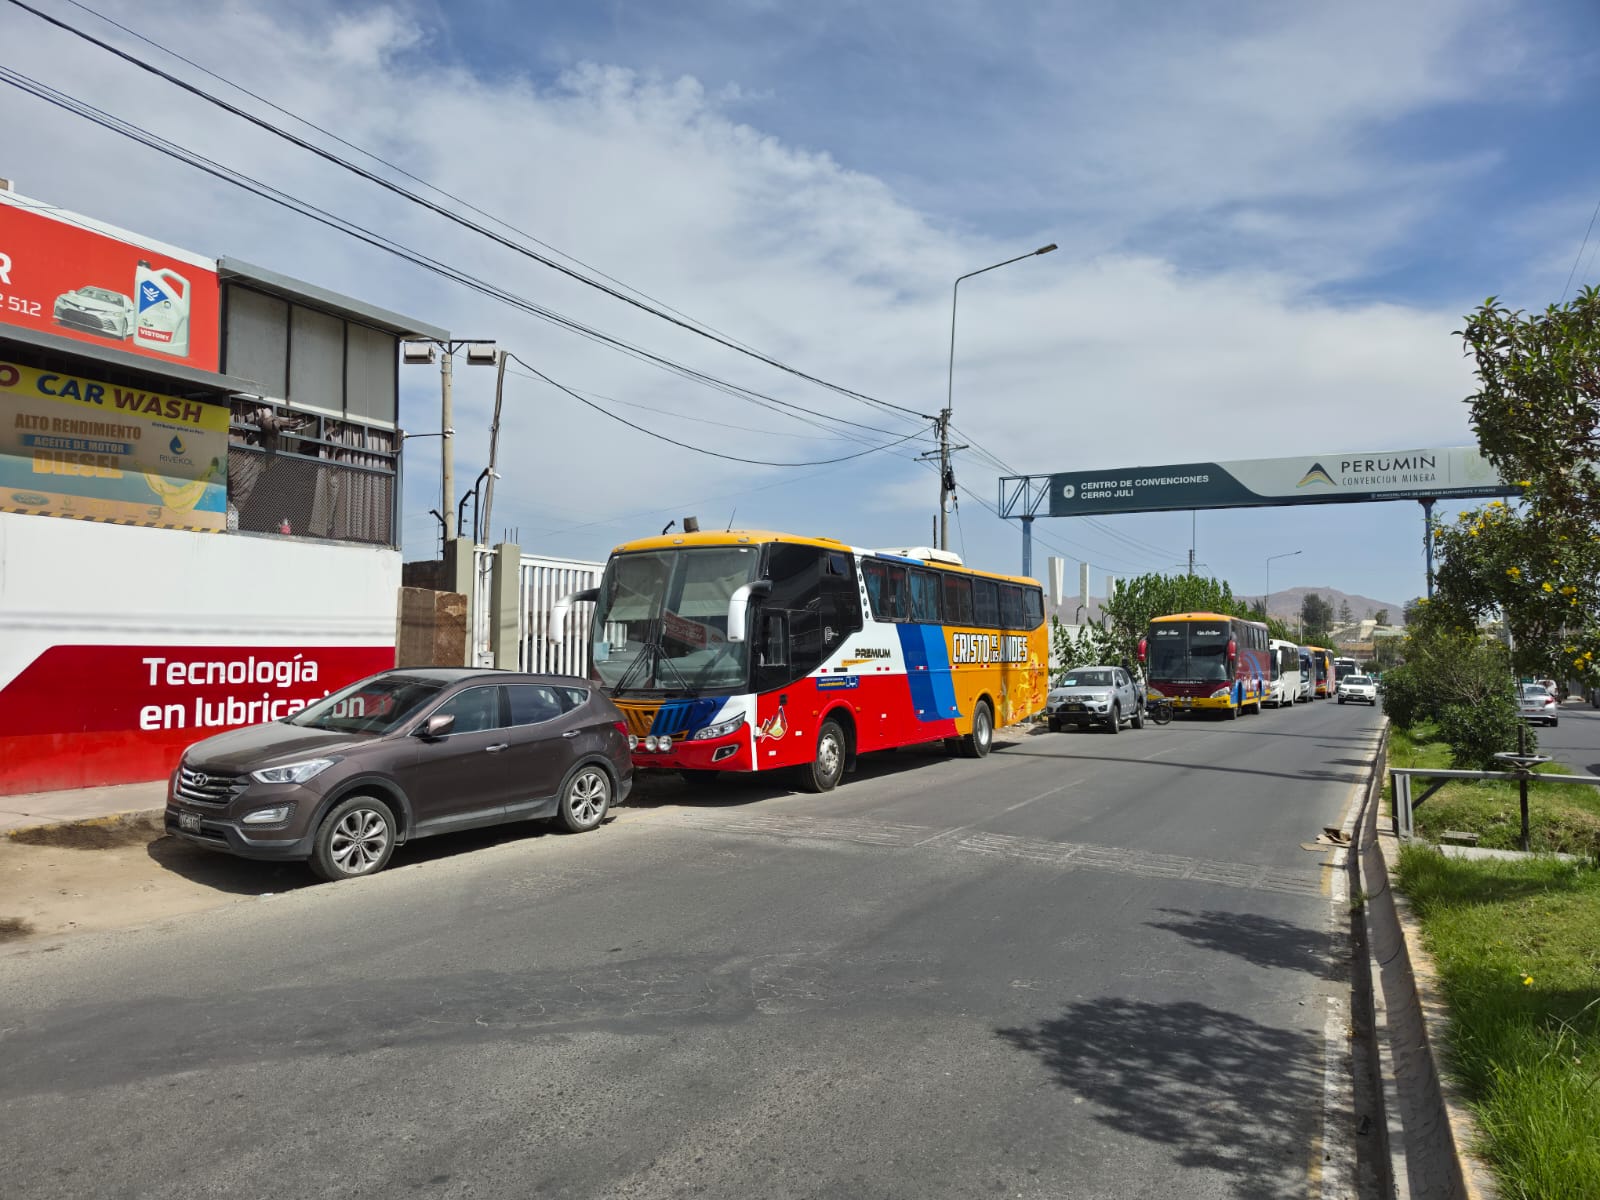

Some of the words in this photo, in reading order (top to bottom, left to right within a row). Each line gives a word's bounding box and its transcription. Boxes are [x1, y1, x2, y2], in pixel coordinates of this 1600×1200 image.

[8, 296, 42, 317] 512
[37, 375, 105, 405] CAR
[113, 388, 203, 423] WASH
[14, 413, 49, 431] ALTO
[52, 418, 141, 440] RENDIMIENTO
[34, 436, 73, 449] ACEITE
[73, 439, 86, 450] DE
[88, 440, 125, 453] MOTOR
[32, 449, 123, 479] DIESEL
[1081, 480, 1118, 490] CENTRO
[1120, 479, 1133, 487] DE
[1135, 475, 1209, 487] CONVENCIONES
[1402, 473, 1436, 483] MINERA
[1081, 490, 1112, 499] CERRO
[1114, 489, 1134, 498] JULI
[855, 648, 892, 658] PREMIUM
[953, 633, 990, 663] CRISTO
[1000, 635, 1028, 663] ANDES
[142, 653, 318, 688] Tecnología
[139, 703, 186, 731] en
